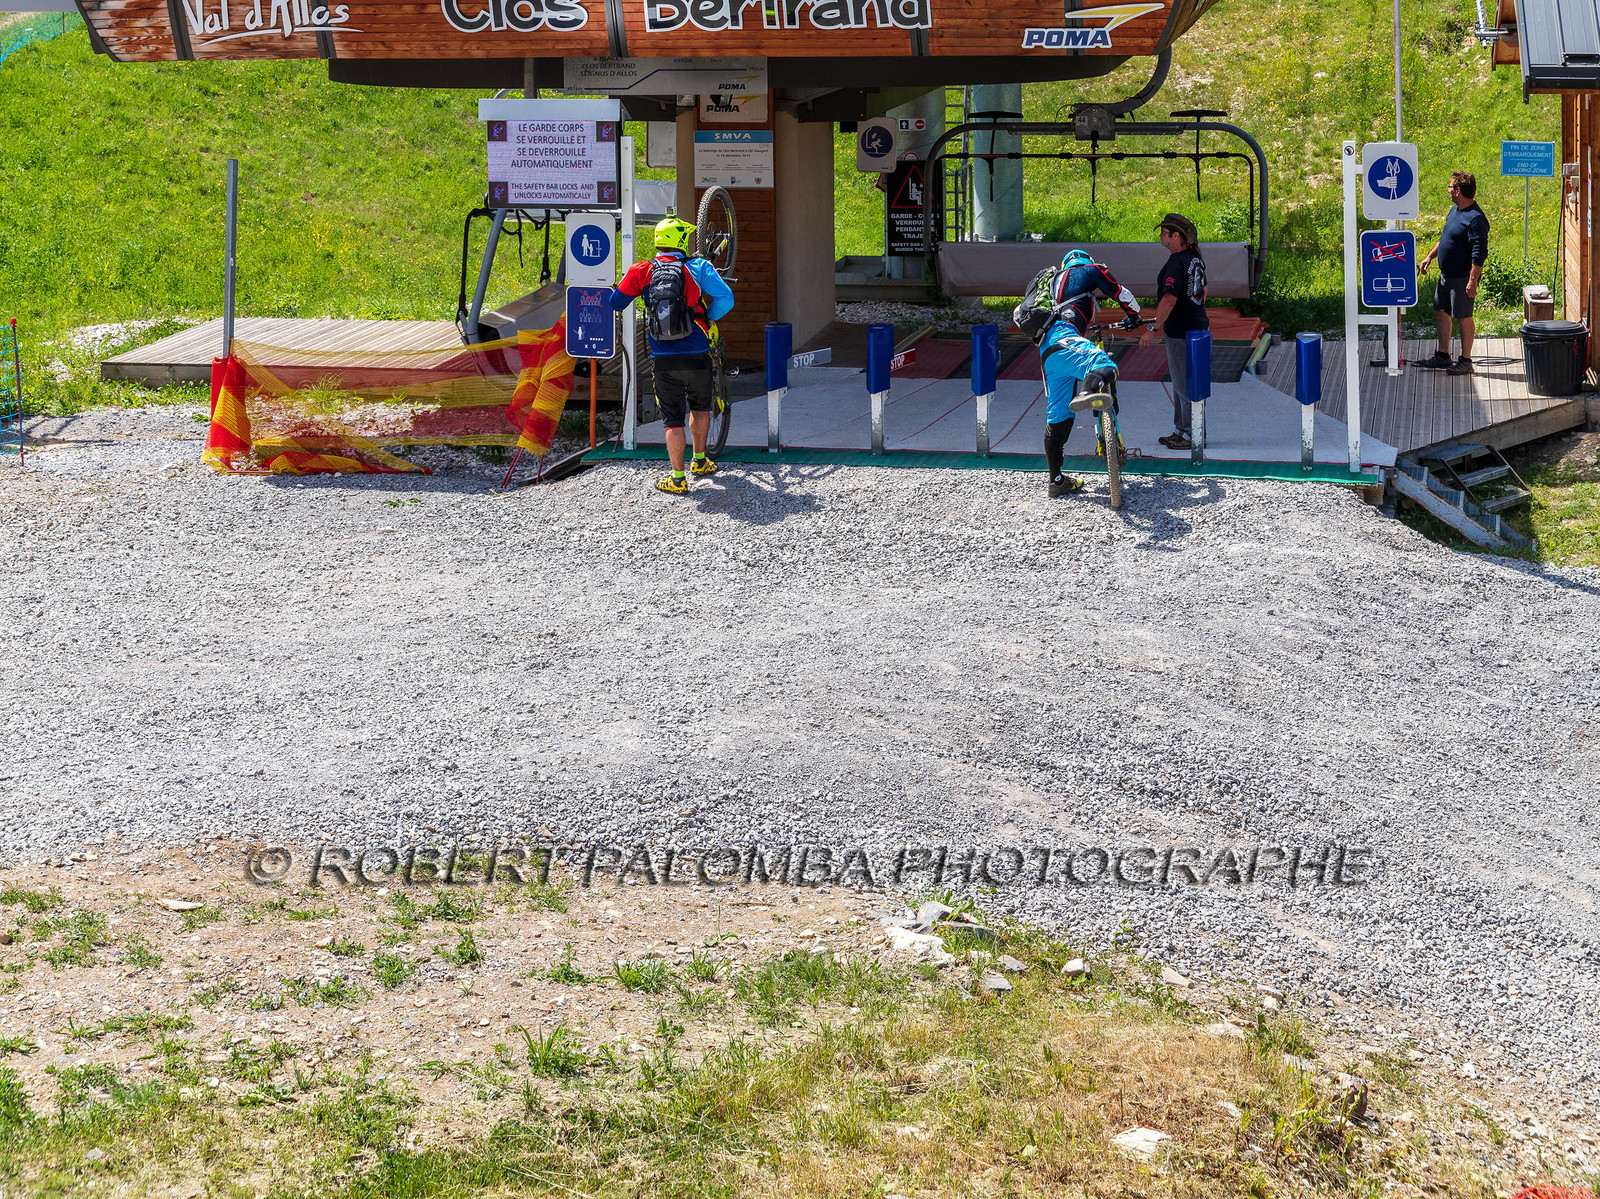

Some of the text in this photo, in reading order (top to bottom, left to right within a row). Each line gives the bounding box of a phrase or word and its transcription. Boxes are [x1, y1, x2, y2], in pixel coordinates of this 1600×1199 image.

[1021, 27, 1113, 49] POMA
[706, 105, 740, 113] POMA
[518, 123, 585, 132] LE GARDE CORPS
[516, 135, 587, 144] SE VERROUILLE ET
[714, 132, 752, 140] SMVA
[517, 147, 587, 156] SE DEVERROUILLE
[510, 159, 593, 170] AUTOMATIQUEMENT
[542, 192, 592, 200] AUTOMATICALLY
[793, 353, 815, 368] STOP
[890, 355, 905, 369] STOP
